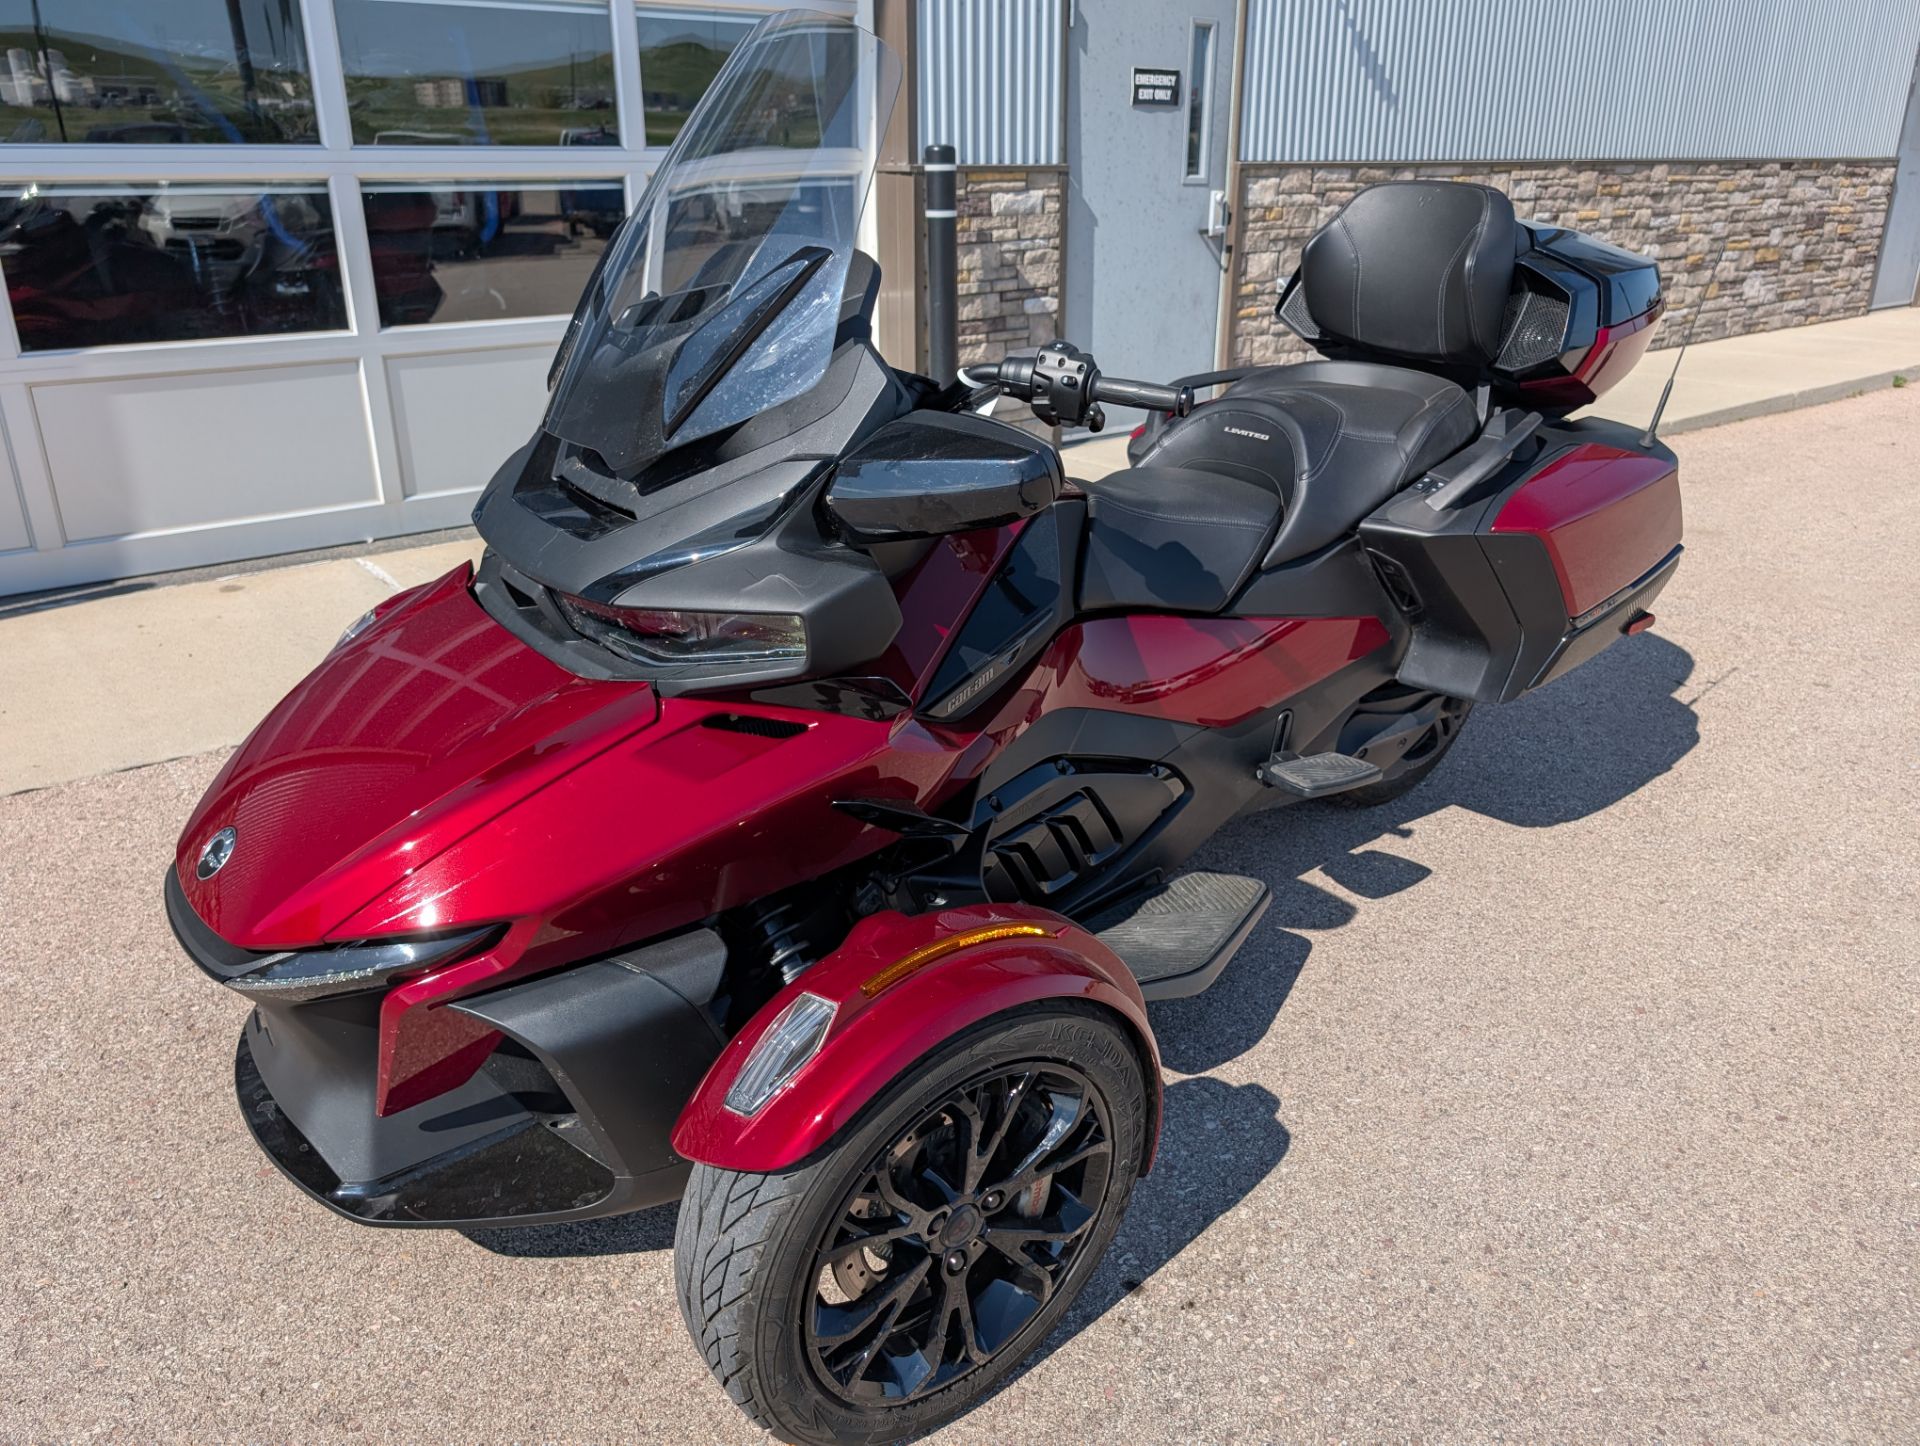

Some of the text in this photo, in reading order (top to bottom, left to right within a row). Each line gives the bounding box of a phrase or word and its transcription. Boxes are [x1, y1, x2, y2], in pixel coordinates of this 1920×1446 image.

[1135, 73, 1177, 87] EMERGENCY
[1138, 88, 1172, 101] EXIT ONLY
[1224, 426, 1270, 441] LIMITED
